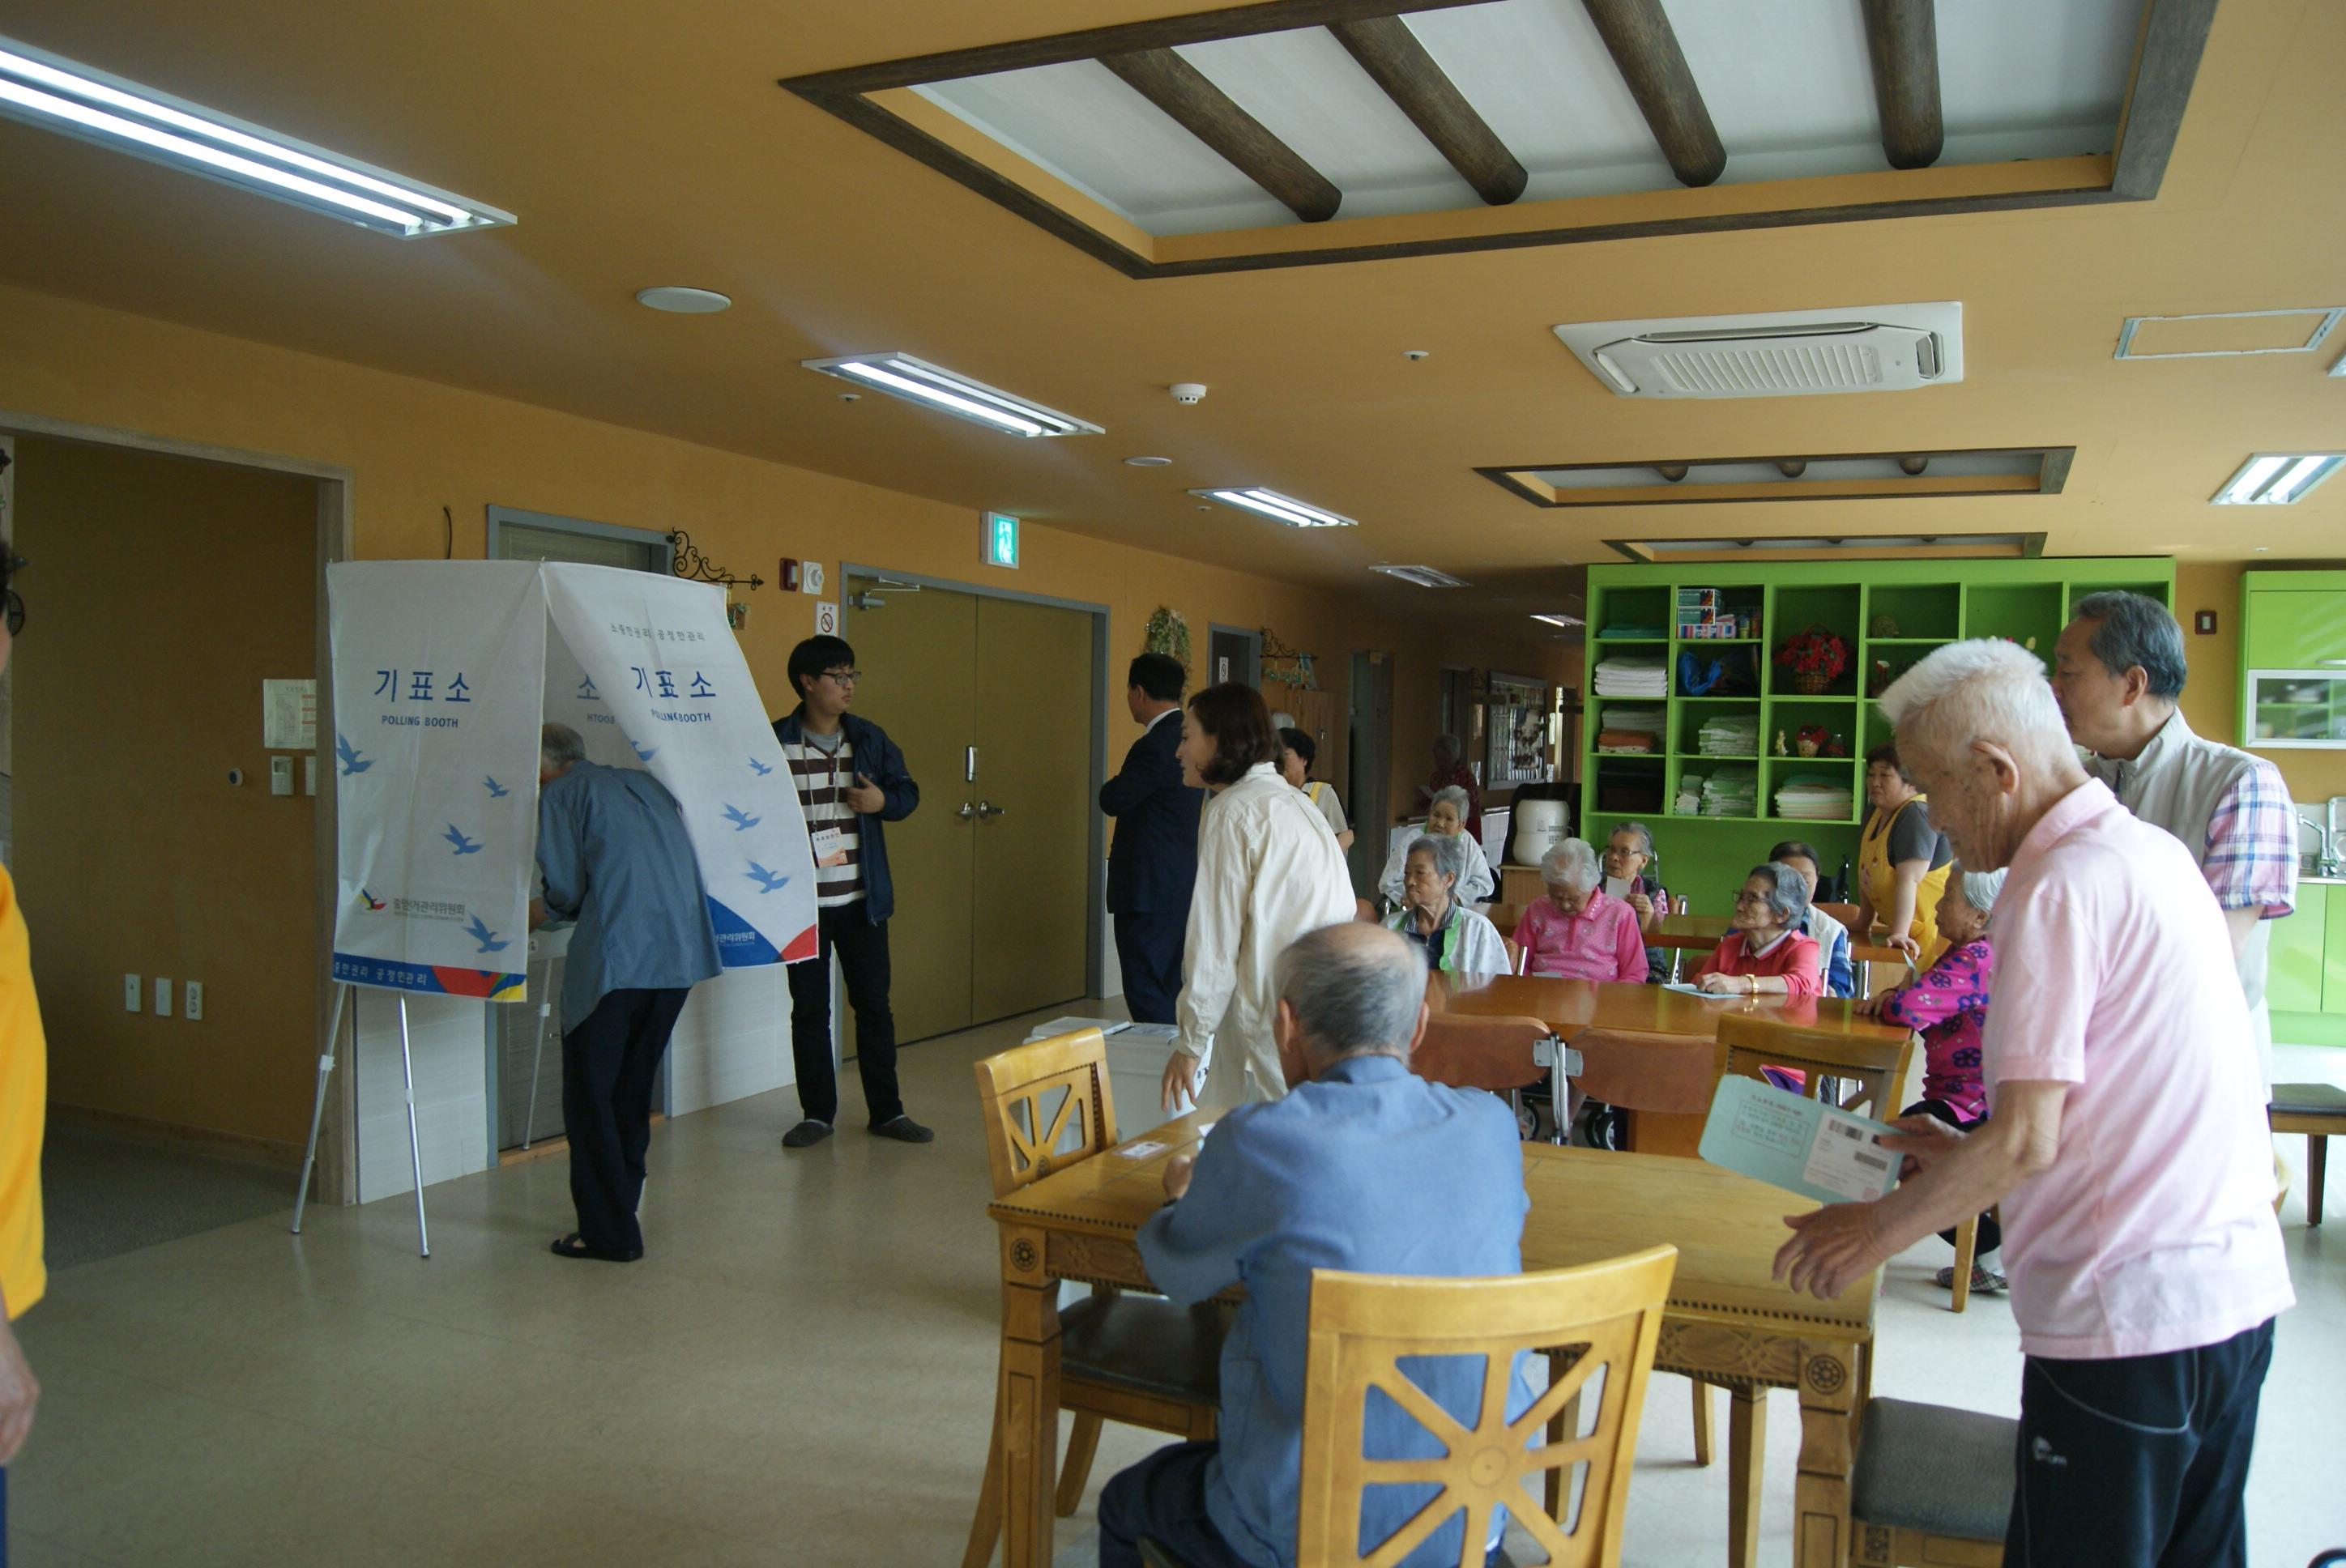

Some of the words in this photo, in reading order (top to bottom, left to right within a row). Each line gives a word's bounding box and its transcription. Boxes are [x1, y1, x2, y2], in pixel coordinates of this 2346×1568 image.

[374, 669, 471, 703] 기표소
[630, 667, 716, 698] 기표소
[382, 715, 420, 726] POLLING
[424, 717, 459, 728] BOOTH
